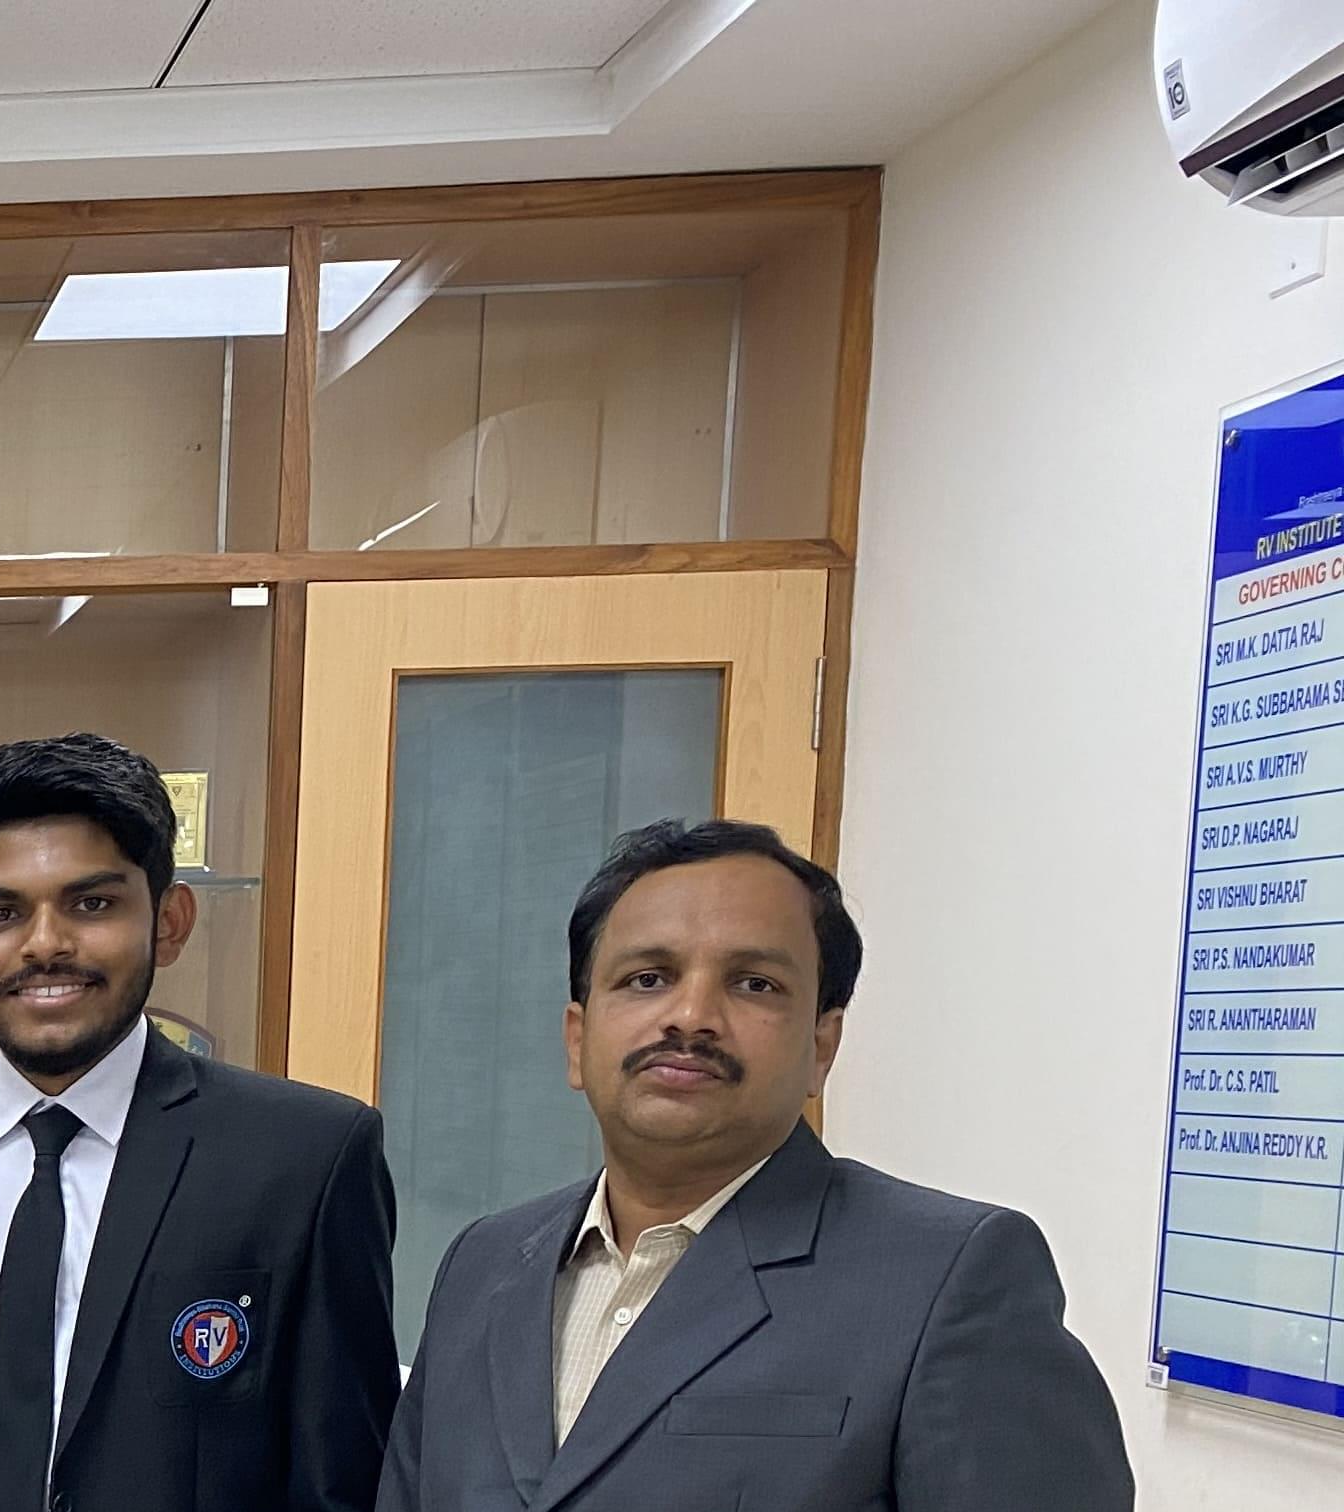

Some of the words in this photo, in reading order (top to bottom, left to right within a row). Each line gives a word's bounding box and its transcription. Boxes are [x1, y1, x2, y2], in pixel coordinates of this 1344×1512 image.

[1256, 536, 1274, 560] RV
[1275, 513, 1343, 554] INSTITUTE
[1238, 562, 1327, 605] GOVERNING
[1215, 641, 1234, 666] SRI
[1236, 635, 1258, 661] M.K.
[1262, 626, 1297, 656] DATTA
[1300, 618, 1324, 646] RAJ
[1211, 703, 1230, 728] SRI
[1231, 699, 1253, 724] K.G.
[1256, 682, 1330, 719] SUBBARAMA
[1206, 765, 1225, 789] SRI
[1225, 759, 1255, 786] A.V.S.
[1258, 750, 1308, 781] MURTHY
[1202, 826, 1219, 850] SRI
[1222, 824, 1241, 848] D.P.
[1243, 815, 1299, 845] NAGARAJ
[1197, 888, 1215, 911] SRI
[1218, 883, 1258, 909] VISHNU
[1260, 879, 1308, 906] BHARAT
[1192, 949, 1210, 971] SRI
[1212, 947, 1230, 970] P.S.
[1233, 943, 1315, 969] NANDAKUMAR
[1188, 1008, 1206, 1031] SRI
[1208, 1008, 1218, 1031] R.
[1219, 1007, 1317, 1031] ANANTHARAMAN
[1183, 1069, 1206, 1091] Prof.
[1209, 1070, 1223, 1092] Dr.
[1226, 1070, 1246, 1092] C.S.
[1249, 1070, 1279, 1093] PATIL
[1179, 1128, 1201, 1150] Prof.
[1204, 1130, 1218, 1152] Dr.
[1262, 1133, 1303, 1158] REDDY
[1305, 1135, 1328, 1160] K.R.
[194, 1326, 229, 1349] RV
